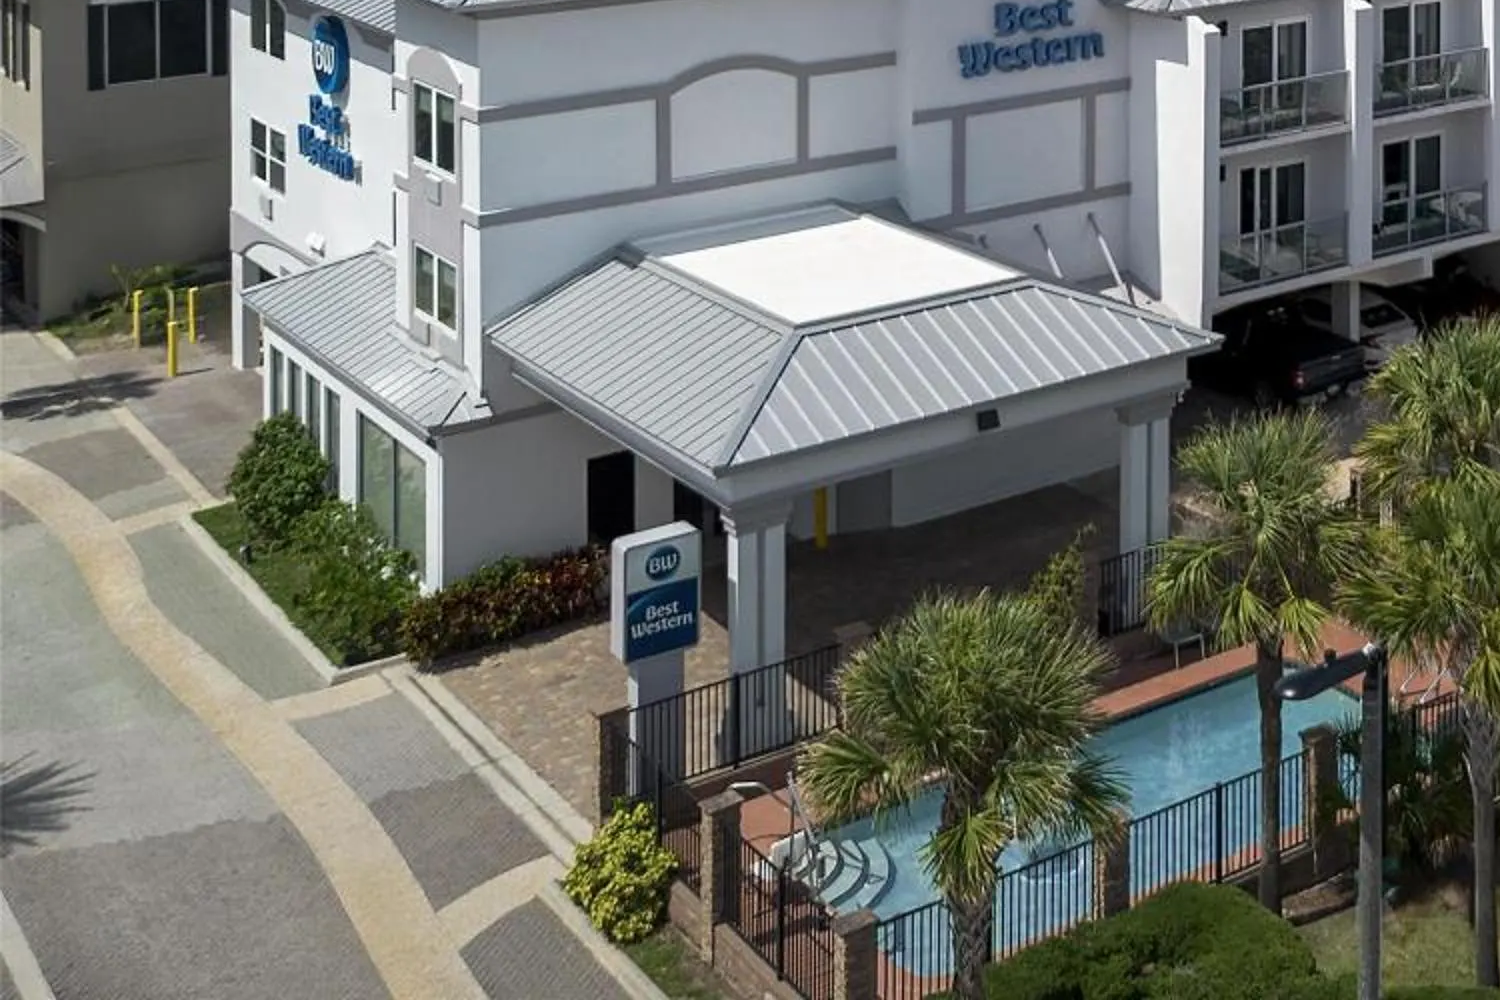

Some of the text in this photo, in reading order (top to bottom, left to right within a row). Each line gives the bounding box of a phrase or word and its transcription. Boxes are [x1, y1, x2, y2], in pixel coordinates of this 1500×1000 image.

[958, 32, 1104, 79] Western
[649, 553, 677, 574] BW
[646, 601, 680, 621] Best
[631, 611, 694, 640] Western
